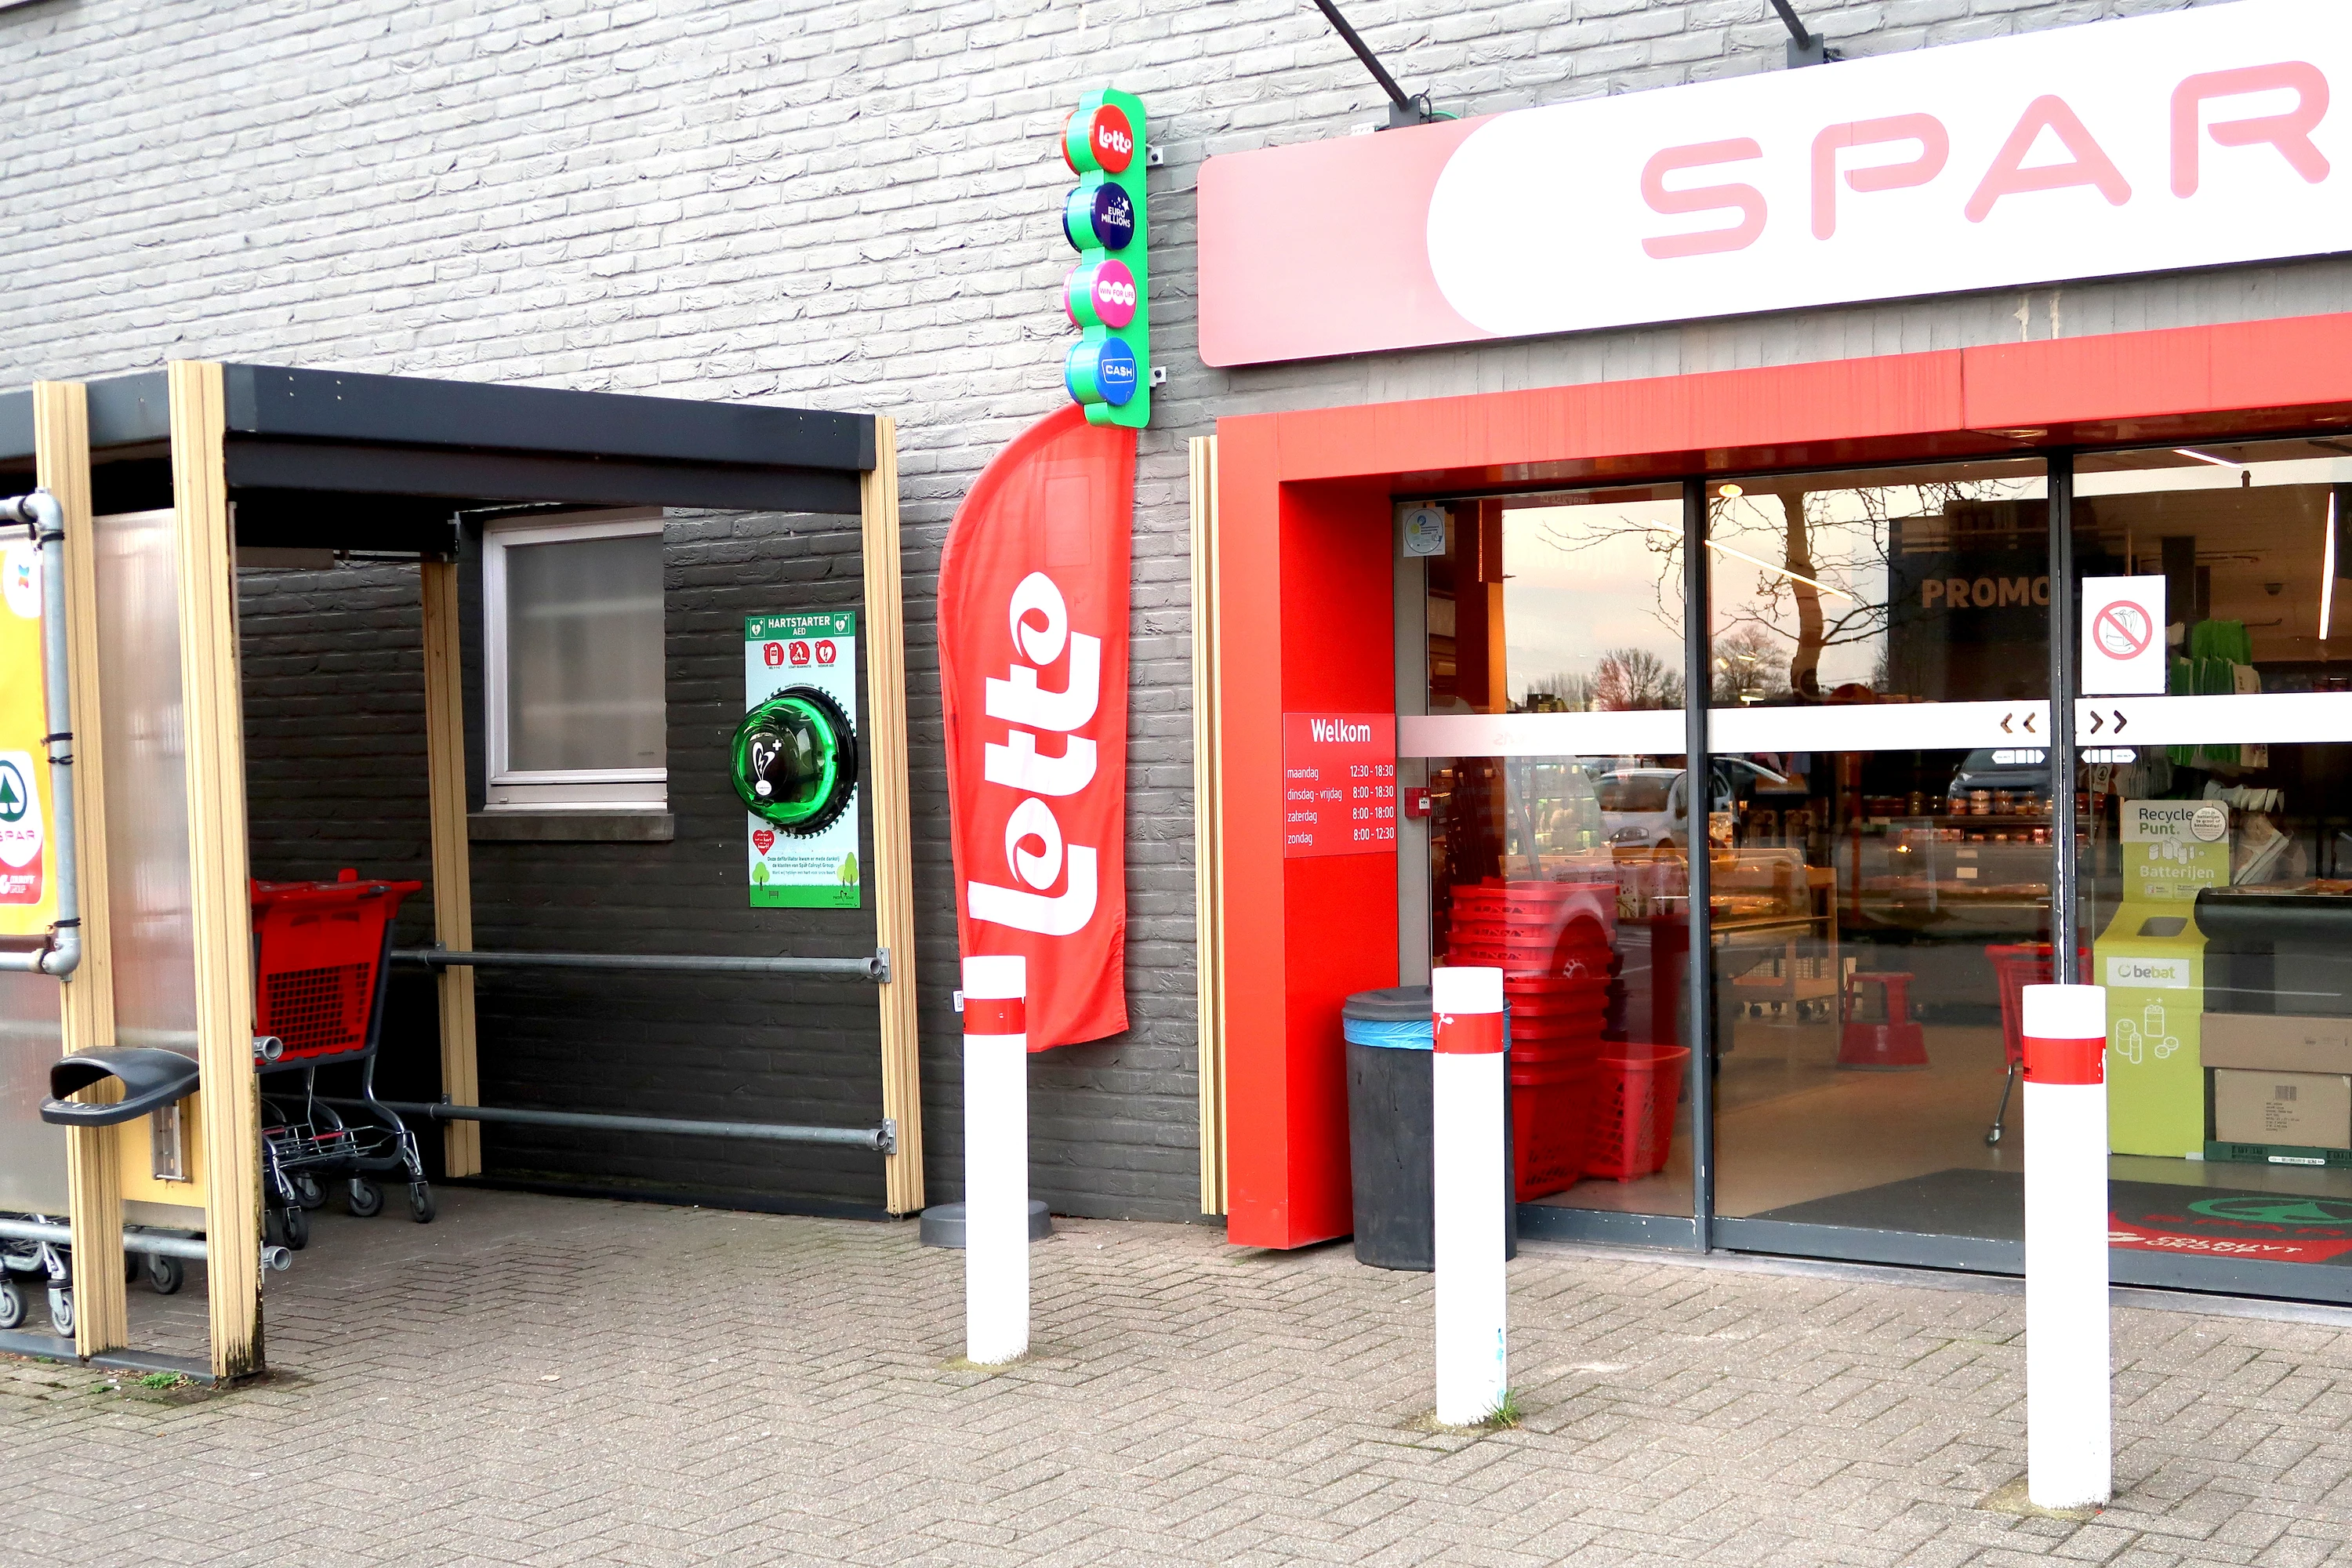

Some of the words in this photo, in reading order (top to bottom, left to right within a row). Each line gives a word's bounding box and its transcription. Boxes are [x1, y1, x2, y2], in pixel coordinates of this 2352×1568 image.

[1099, 125, 1132, 154] Lotto
[1640, 60, 2331, 260] SPAR
[1101, 213, 1131, 227] MILLIONS
[1108, 206, 1126, 218] EURO
[768, 616, 830, 628] HARTSTARTER
[793, 627, 806, 636] AED
[1311, 719, 1370, 742] Welkom
[967, 571, 1101, 937] Lotto
[1287, 767, 1319, 781] maandag
[1350, 765, 1369, 778] 12:30
[1374, 764, 1394, 777] 18:30
[1287, 789, 1314, 802] dinsdag
[1319, 787, 1342, 801] vrijdag
[1352, 786, 1369, 798] 8:00
[1374, 786, 1394, 797] 18:30
[1287, 811, 1317, 824] zaterdag
[1352, 808, 1369, 819] 8:00
[1374, 807, 1394, 818] 18:00
[2139, 808, 2194, 824] Recycle
[1287, 833, 1312, 846] zondag
[1353, 829, 1370, 841] 8:00
[1375, 827, 1395, 840] 12:30
[2140, 822, 2180, 835] Punt.
[2140, 866, 2215, 880] Batterijen
[2134, 964, 2175, 978] bebat
